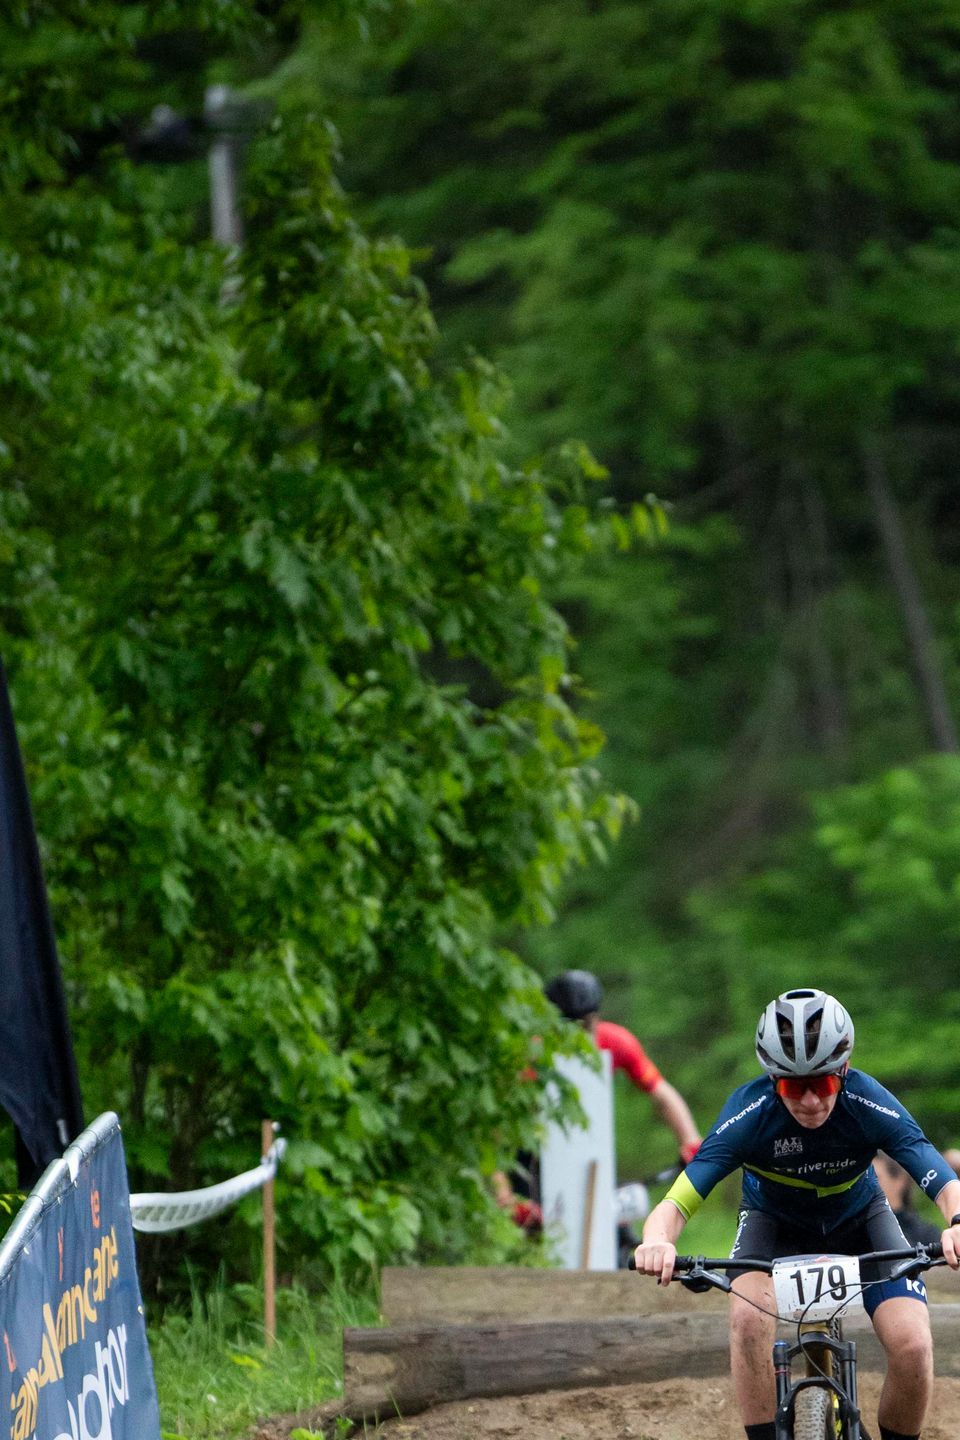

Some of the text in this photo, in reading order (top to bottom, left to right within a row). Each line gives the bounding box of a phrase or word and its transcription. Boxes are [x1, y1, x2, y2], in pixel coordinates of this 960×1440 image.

[715, 1094, 767, 1135] cannondale
[797, 1157, 857, 1175] riverside
[790, 1264, 848, 1306] 179
